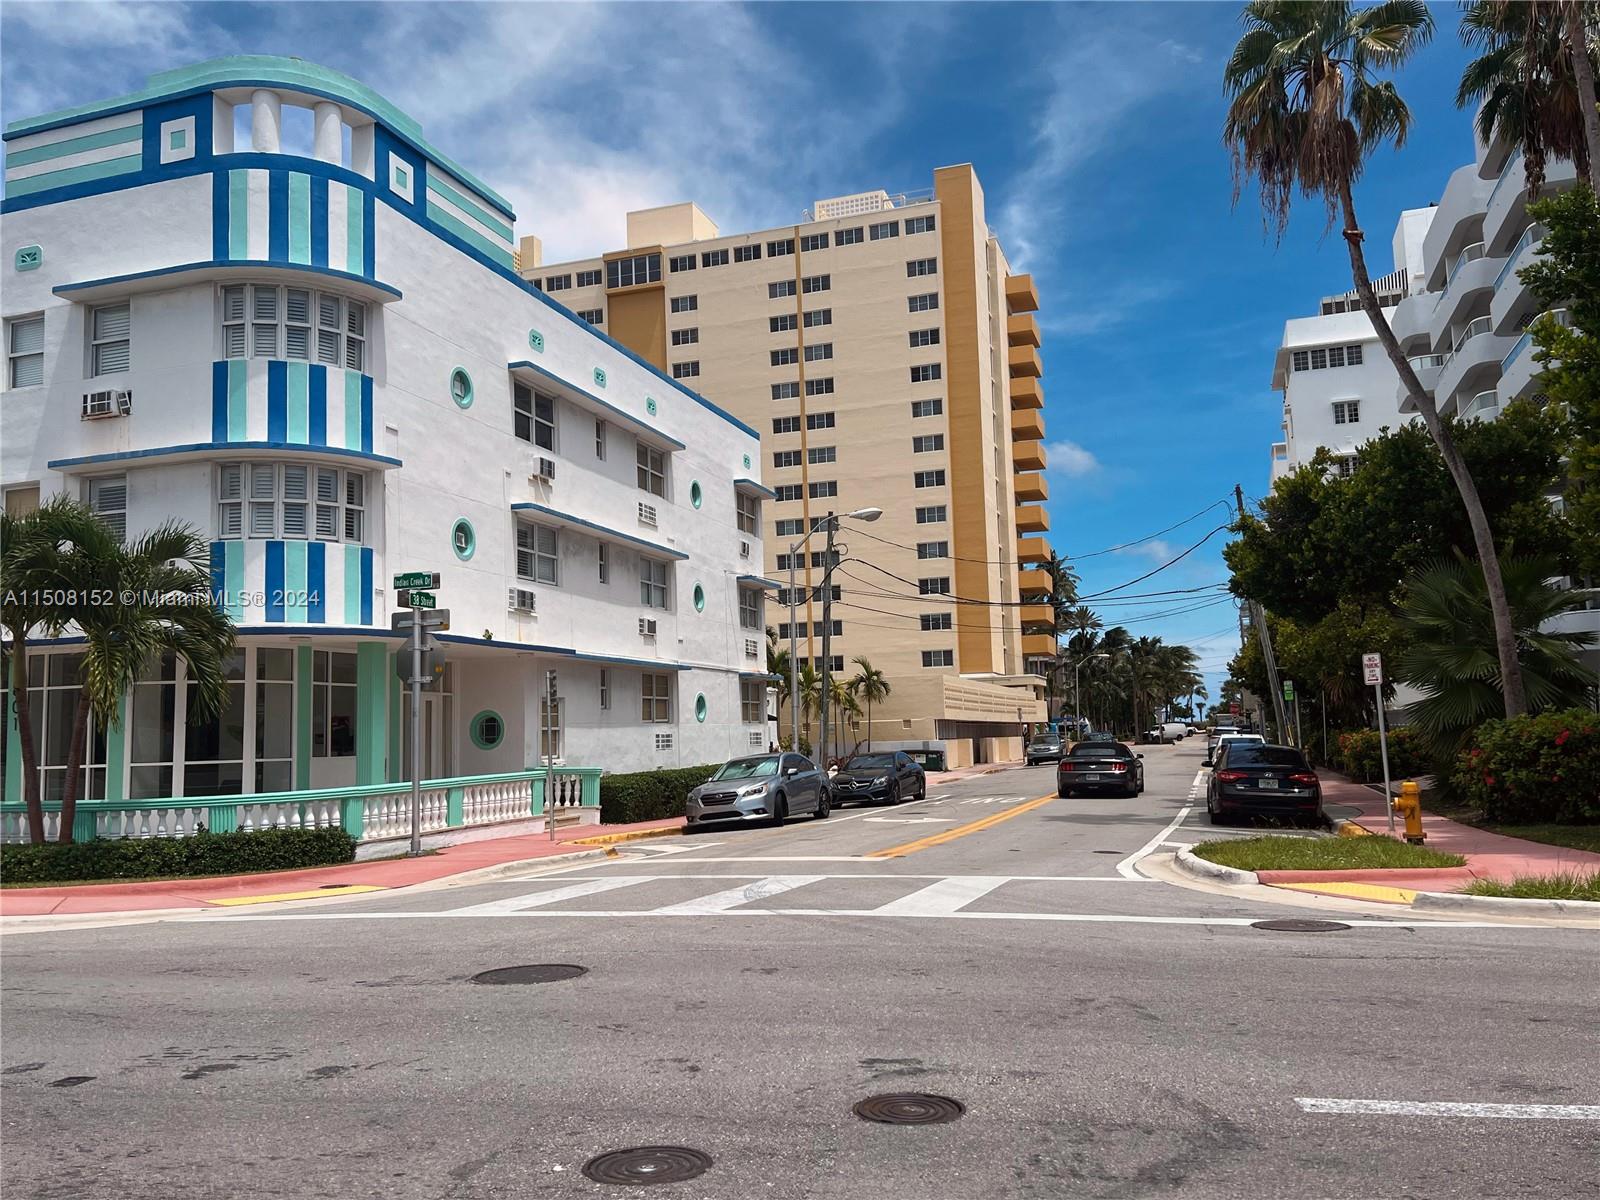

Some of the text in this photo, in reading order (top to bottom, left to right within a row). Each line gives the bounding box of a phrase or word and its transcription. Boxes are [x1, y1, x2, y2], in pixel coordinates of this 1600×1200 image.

[410, 578, 423, 586] Creek
[412, 594, 434, 606] 38 Street
